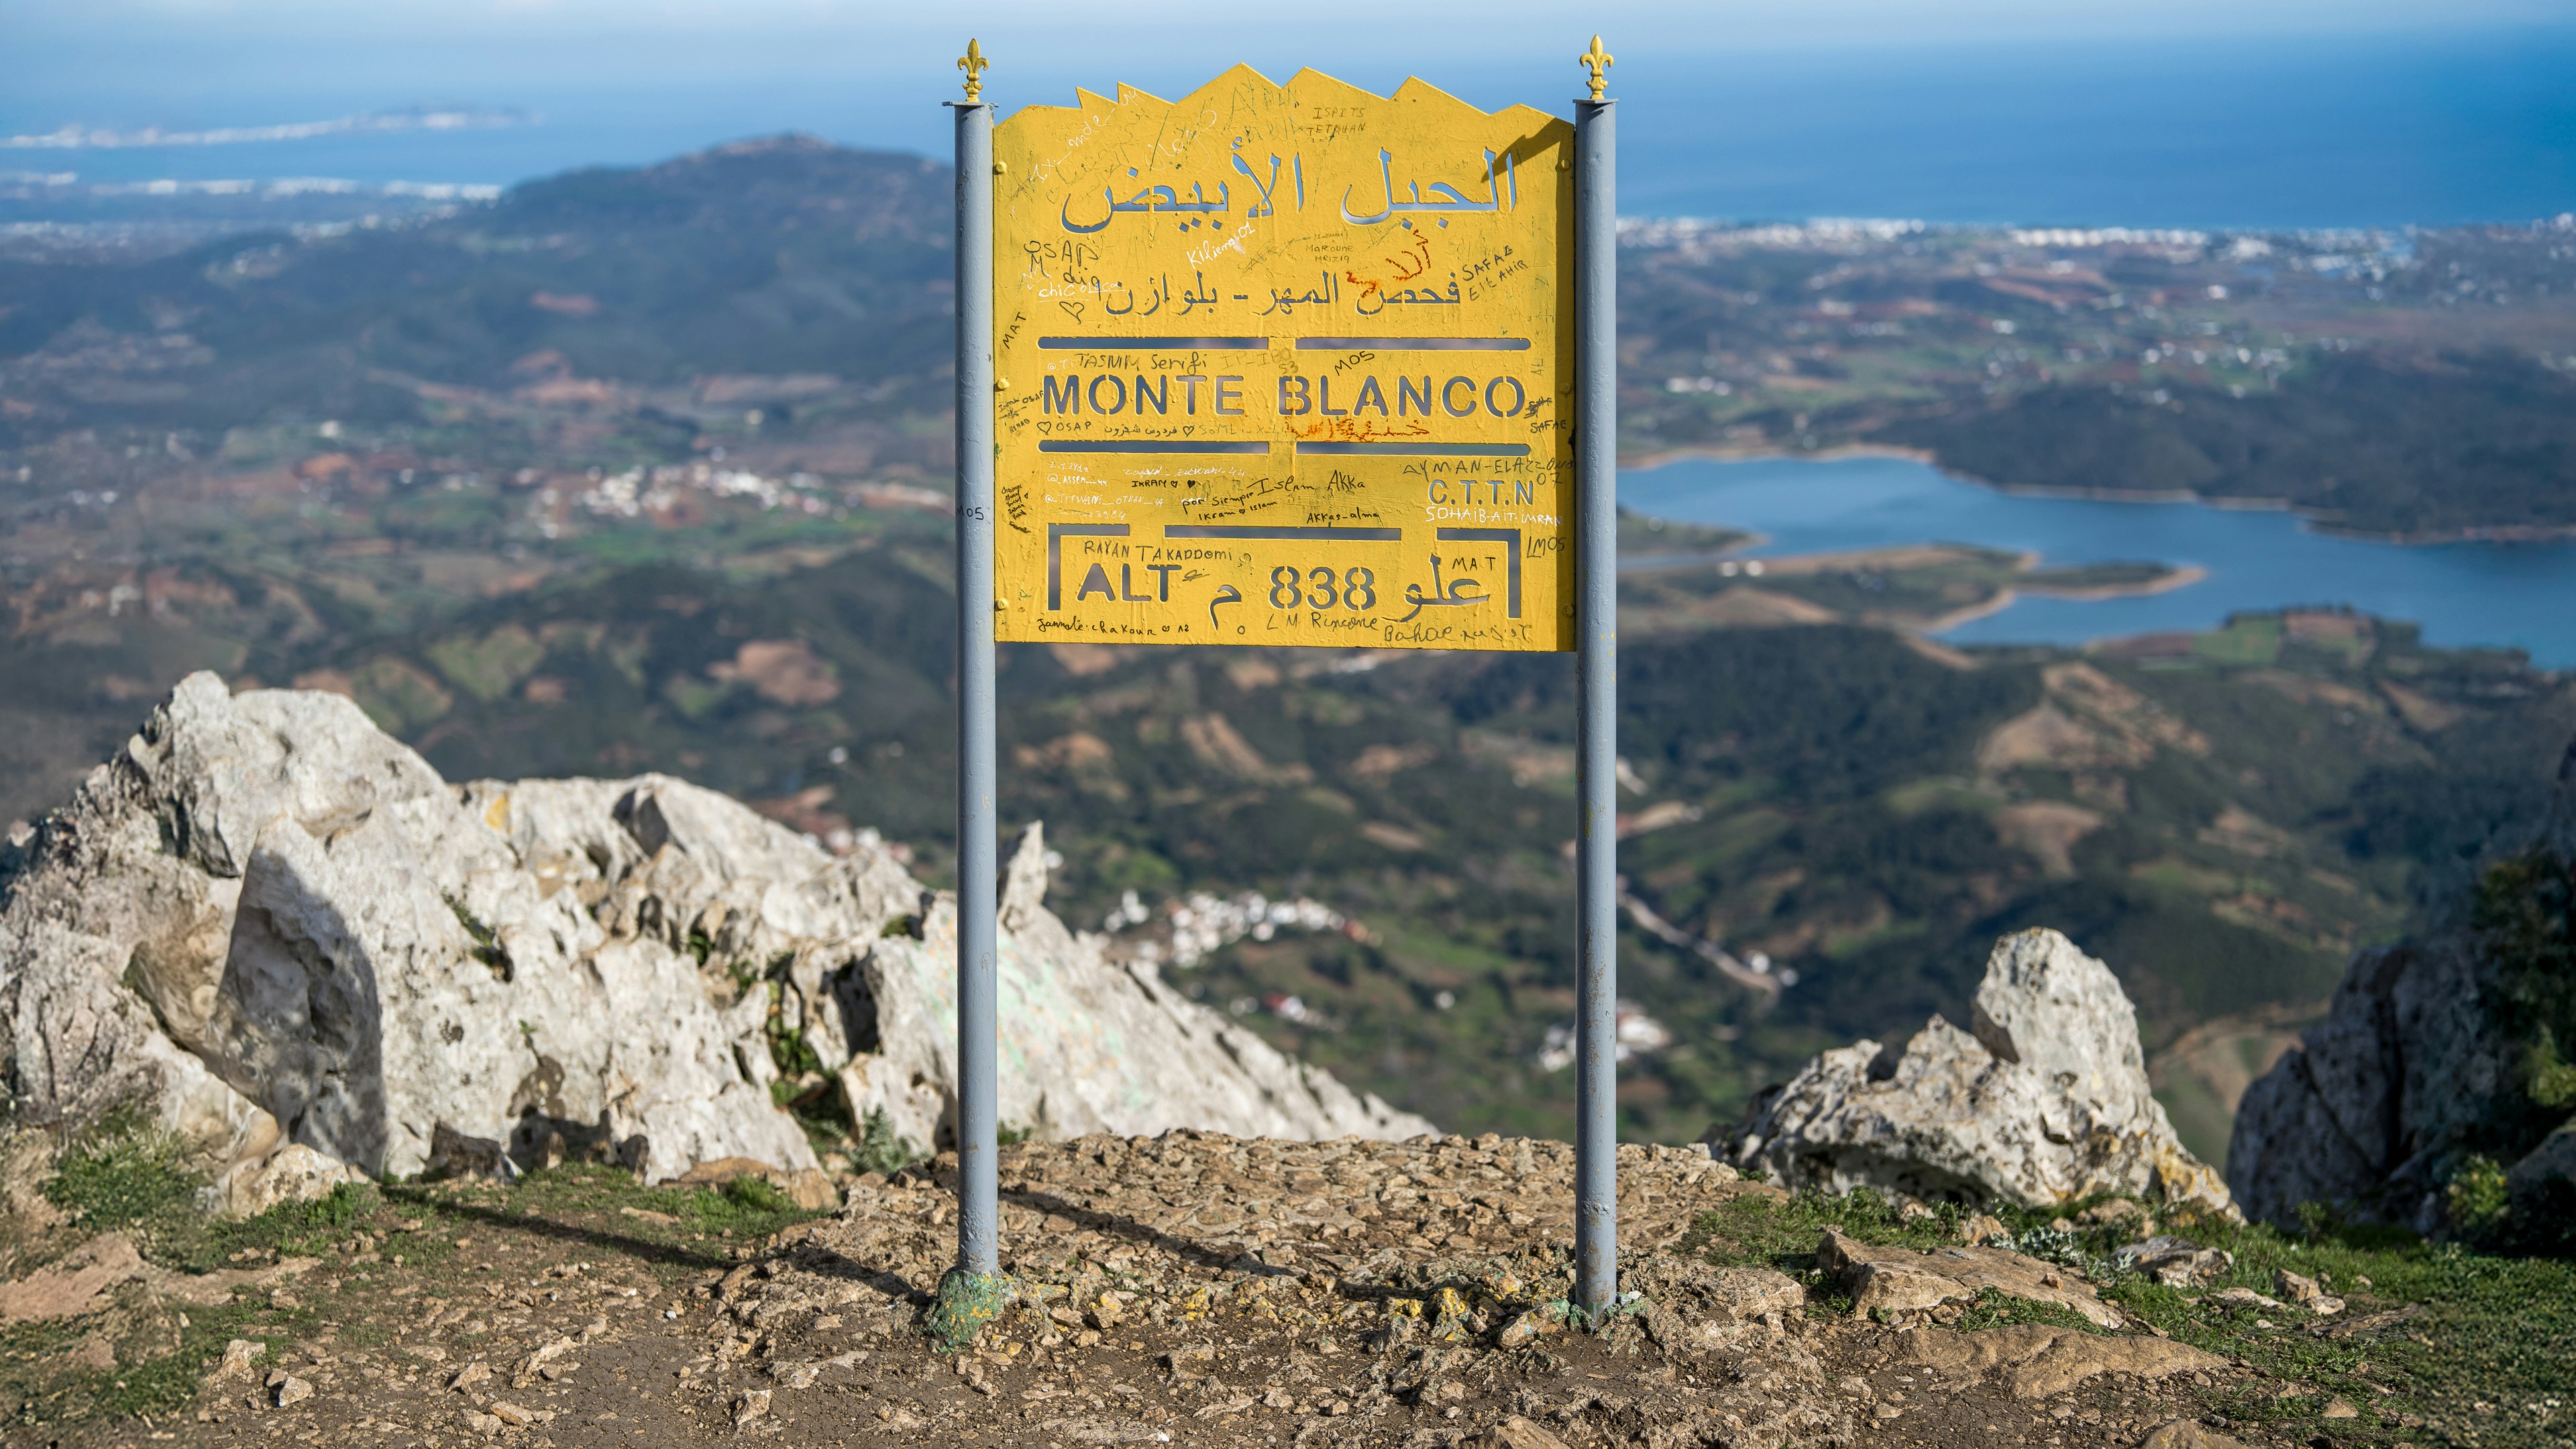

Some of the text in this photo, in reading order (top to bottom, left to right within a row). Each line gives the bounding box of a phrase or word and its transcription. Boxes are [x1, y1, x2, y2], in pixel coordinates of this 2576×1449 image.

[1061, 136, 1303, 233] الأبيض
[1342, 146, 1517, 229] الجبل
[1252, 270, 1339, 315] المهر
[1356, 272, 1460, 315] فحص
[1003, 312, 1026, 349] MAT
[1043, 374, 1244, 416] MONTE
[1278, 375, 1525, 417] BLANCO
[1056, 421, 1091, 431] OSAP
[1132, 480, 1167, 488] IKRAM
[1429, 480, 1533, 505] C.T.T.N
[1084, 541, 1130, 558] RAYAN
[1452, 557, 1496, 571] MAT
[1077, 564, 1376, 610] ALT 838
[1383, 553, 1491, 623] علو
